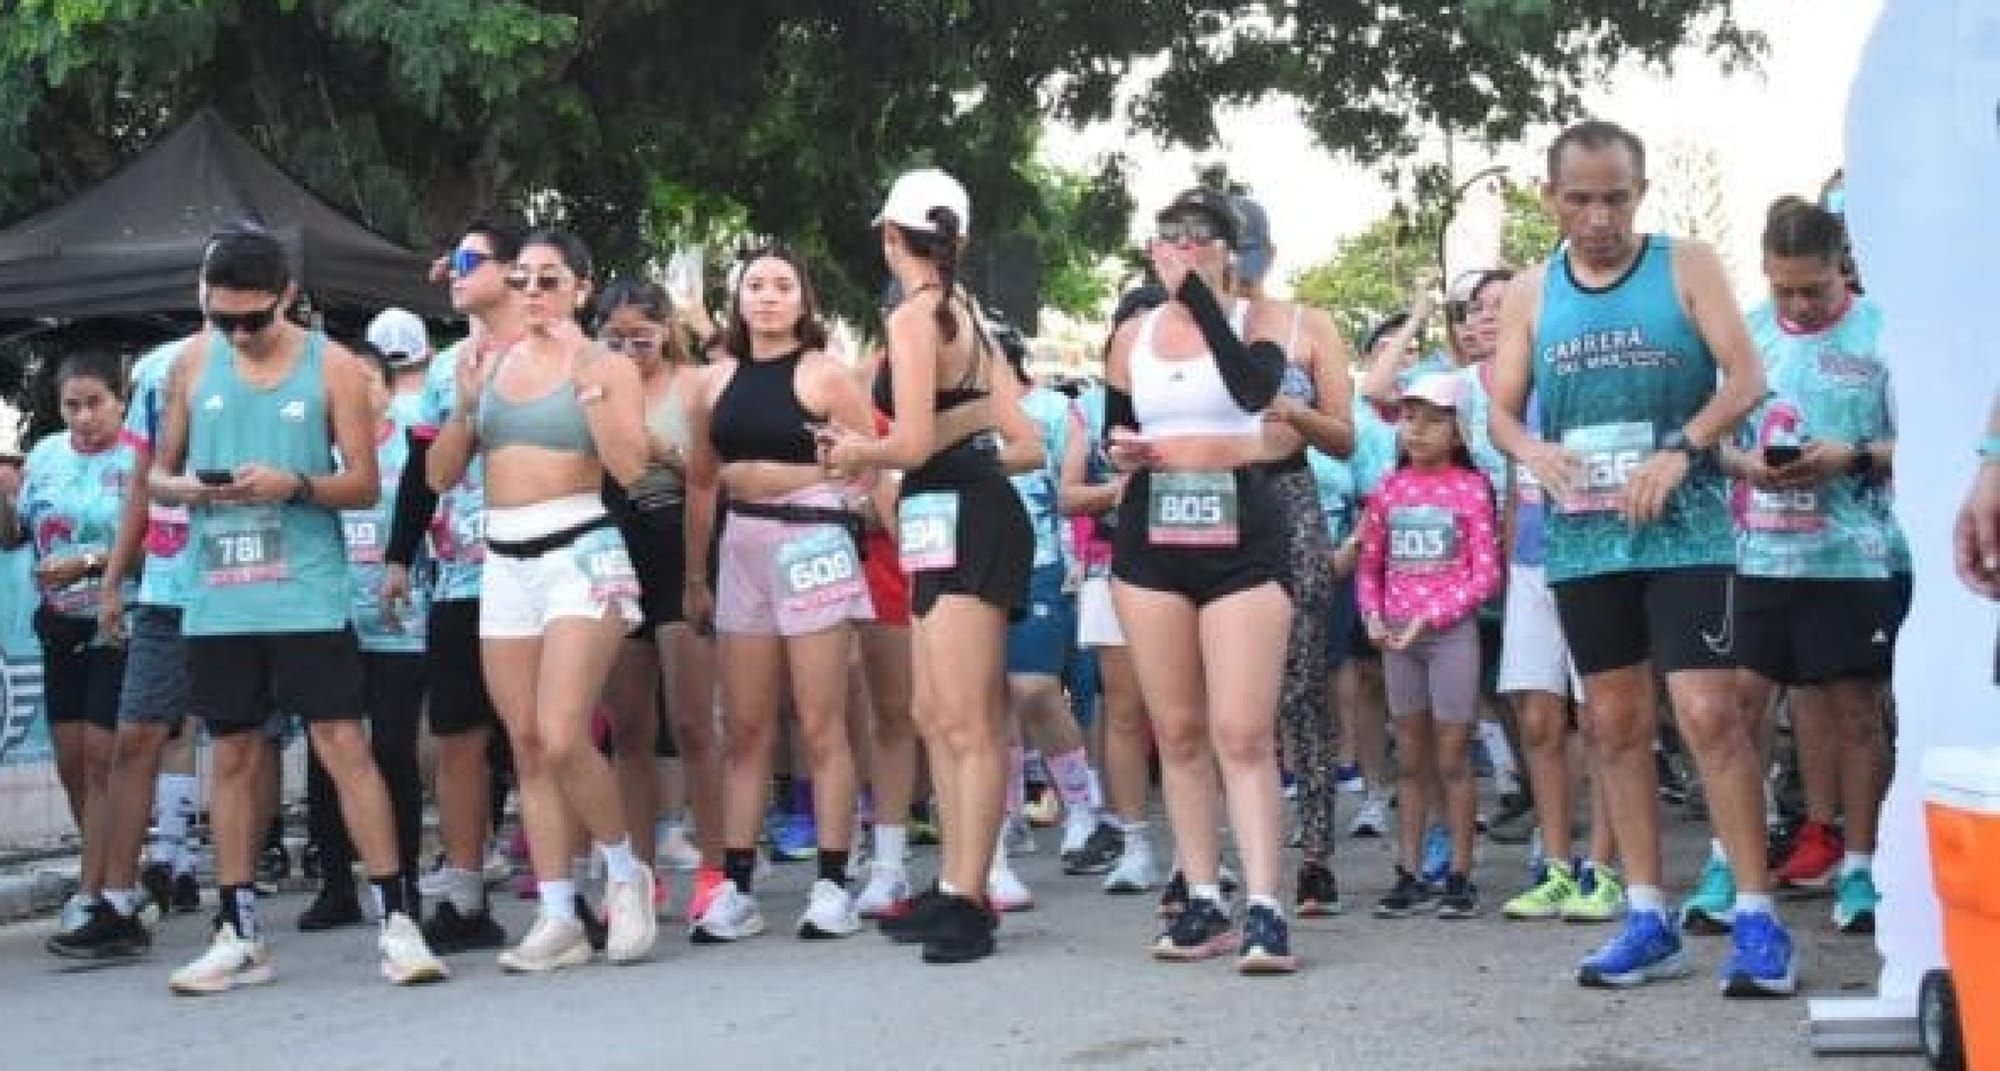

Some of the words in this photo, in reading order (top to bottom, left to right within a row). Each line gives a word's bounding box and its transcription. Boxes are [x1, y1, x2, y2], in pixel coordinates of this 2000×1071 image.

[1543, 327, 1643, 363] CARRERA
[1161, 495, 1222, 524] 805
[219, 536, 265, 565] 781
